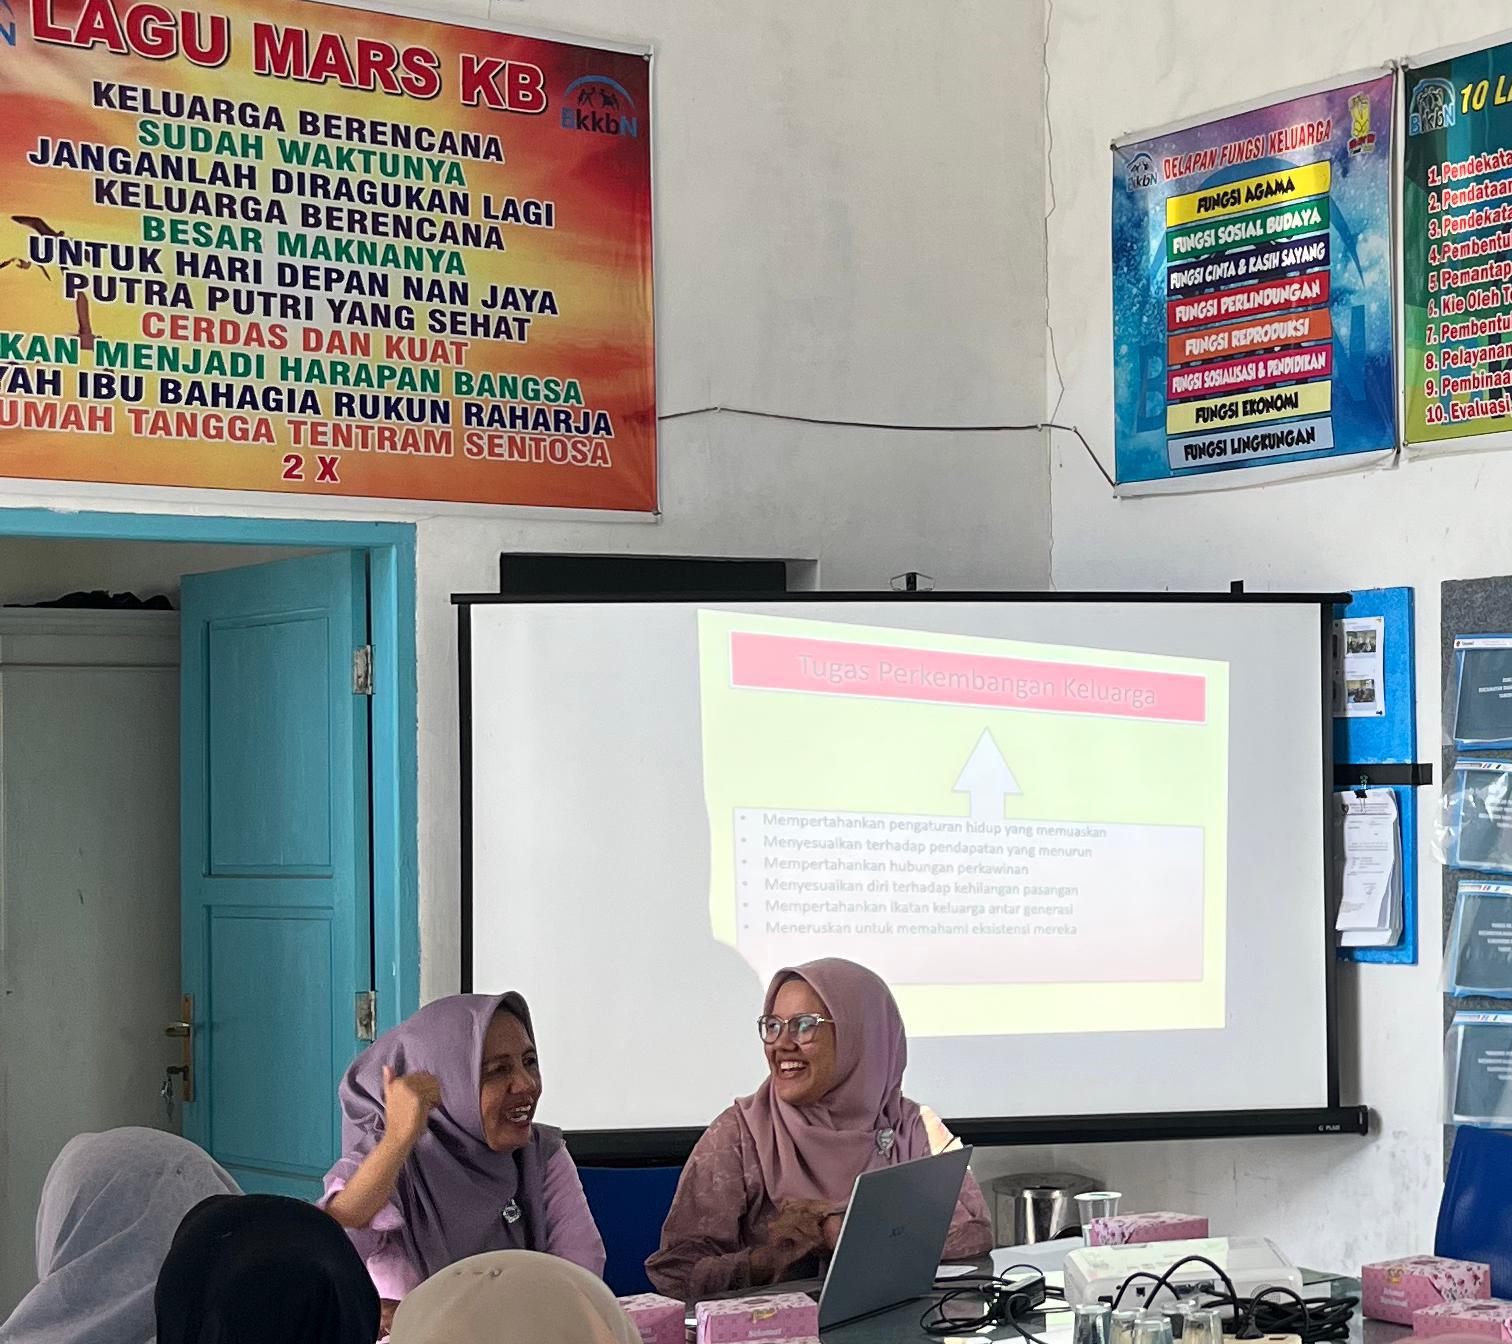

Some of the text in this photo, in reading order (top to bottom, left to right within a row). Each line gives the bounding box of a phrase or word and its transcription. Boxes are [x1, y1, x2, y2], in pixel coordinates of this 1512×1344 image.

[252, 22, 440, 99] MARS
[460, 54, 547, 114] KB
[93, 81, 504, 162] KELUARGA BERENCANA
[1460, 80, 1488, 114] 10
[138, 120, 465, 186] SUDAH WAKTUNYA
[1164, 147, 1216, 182] DELAPAN
[1220, 137, 1265, 168] FUNGSI
[1270, 119, 1332, 155] KELUARGA
[1428, 167, 1442, 186] 1.
[29, 138, 554, 227] JANGANLAH DIRAGUKAN LAGI
[1197, 177, 1295, 213] FUNGSI AGAMA
[95, 179, 504, 250] KELUARGA BERENCANA
[1173, 207, 1322, 254] FUNGSI SOSIAL BUDAYA
[143, 215, 466, 275] BESAR MAKNANYA
[29, 236, 558, 315] UNTUK HARI DEPAN NAN JAYA
[1176, 280, 1320, 323] FUNGSI PERLINDUNGAN
[65, 273, 531, 342] PUTRA PUTRI YANG SEHAT
[142, 312, 469, 366] CERDAS DAN KUAT
[0, 332, 583, 404] KAN MENJADI HARAPAN BANGSA
[1425, 379, 1438, 396] 9.
[79, 372, 143, 402] IBU
[160, 378, 321, 415] BAHAGIA
[335, 391, 450, 424] RUKUN
[464, 402, 613, 436] RAHARJA
[1195, 392, 1299, 424] FUNGSI EKONOMI
[1426, 405, 1448, 424] 10.
[128, 409, 274, 444] TANGGA
[288, 420, 451, 455] TENTRAM
[466, 432, 611, 466] SENTOSA
[282, 454, 339, 481] 2 X
[798, 654, 1156, 708] Tugas Perkembangan Keluarga
